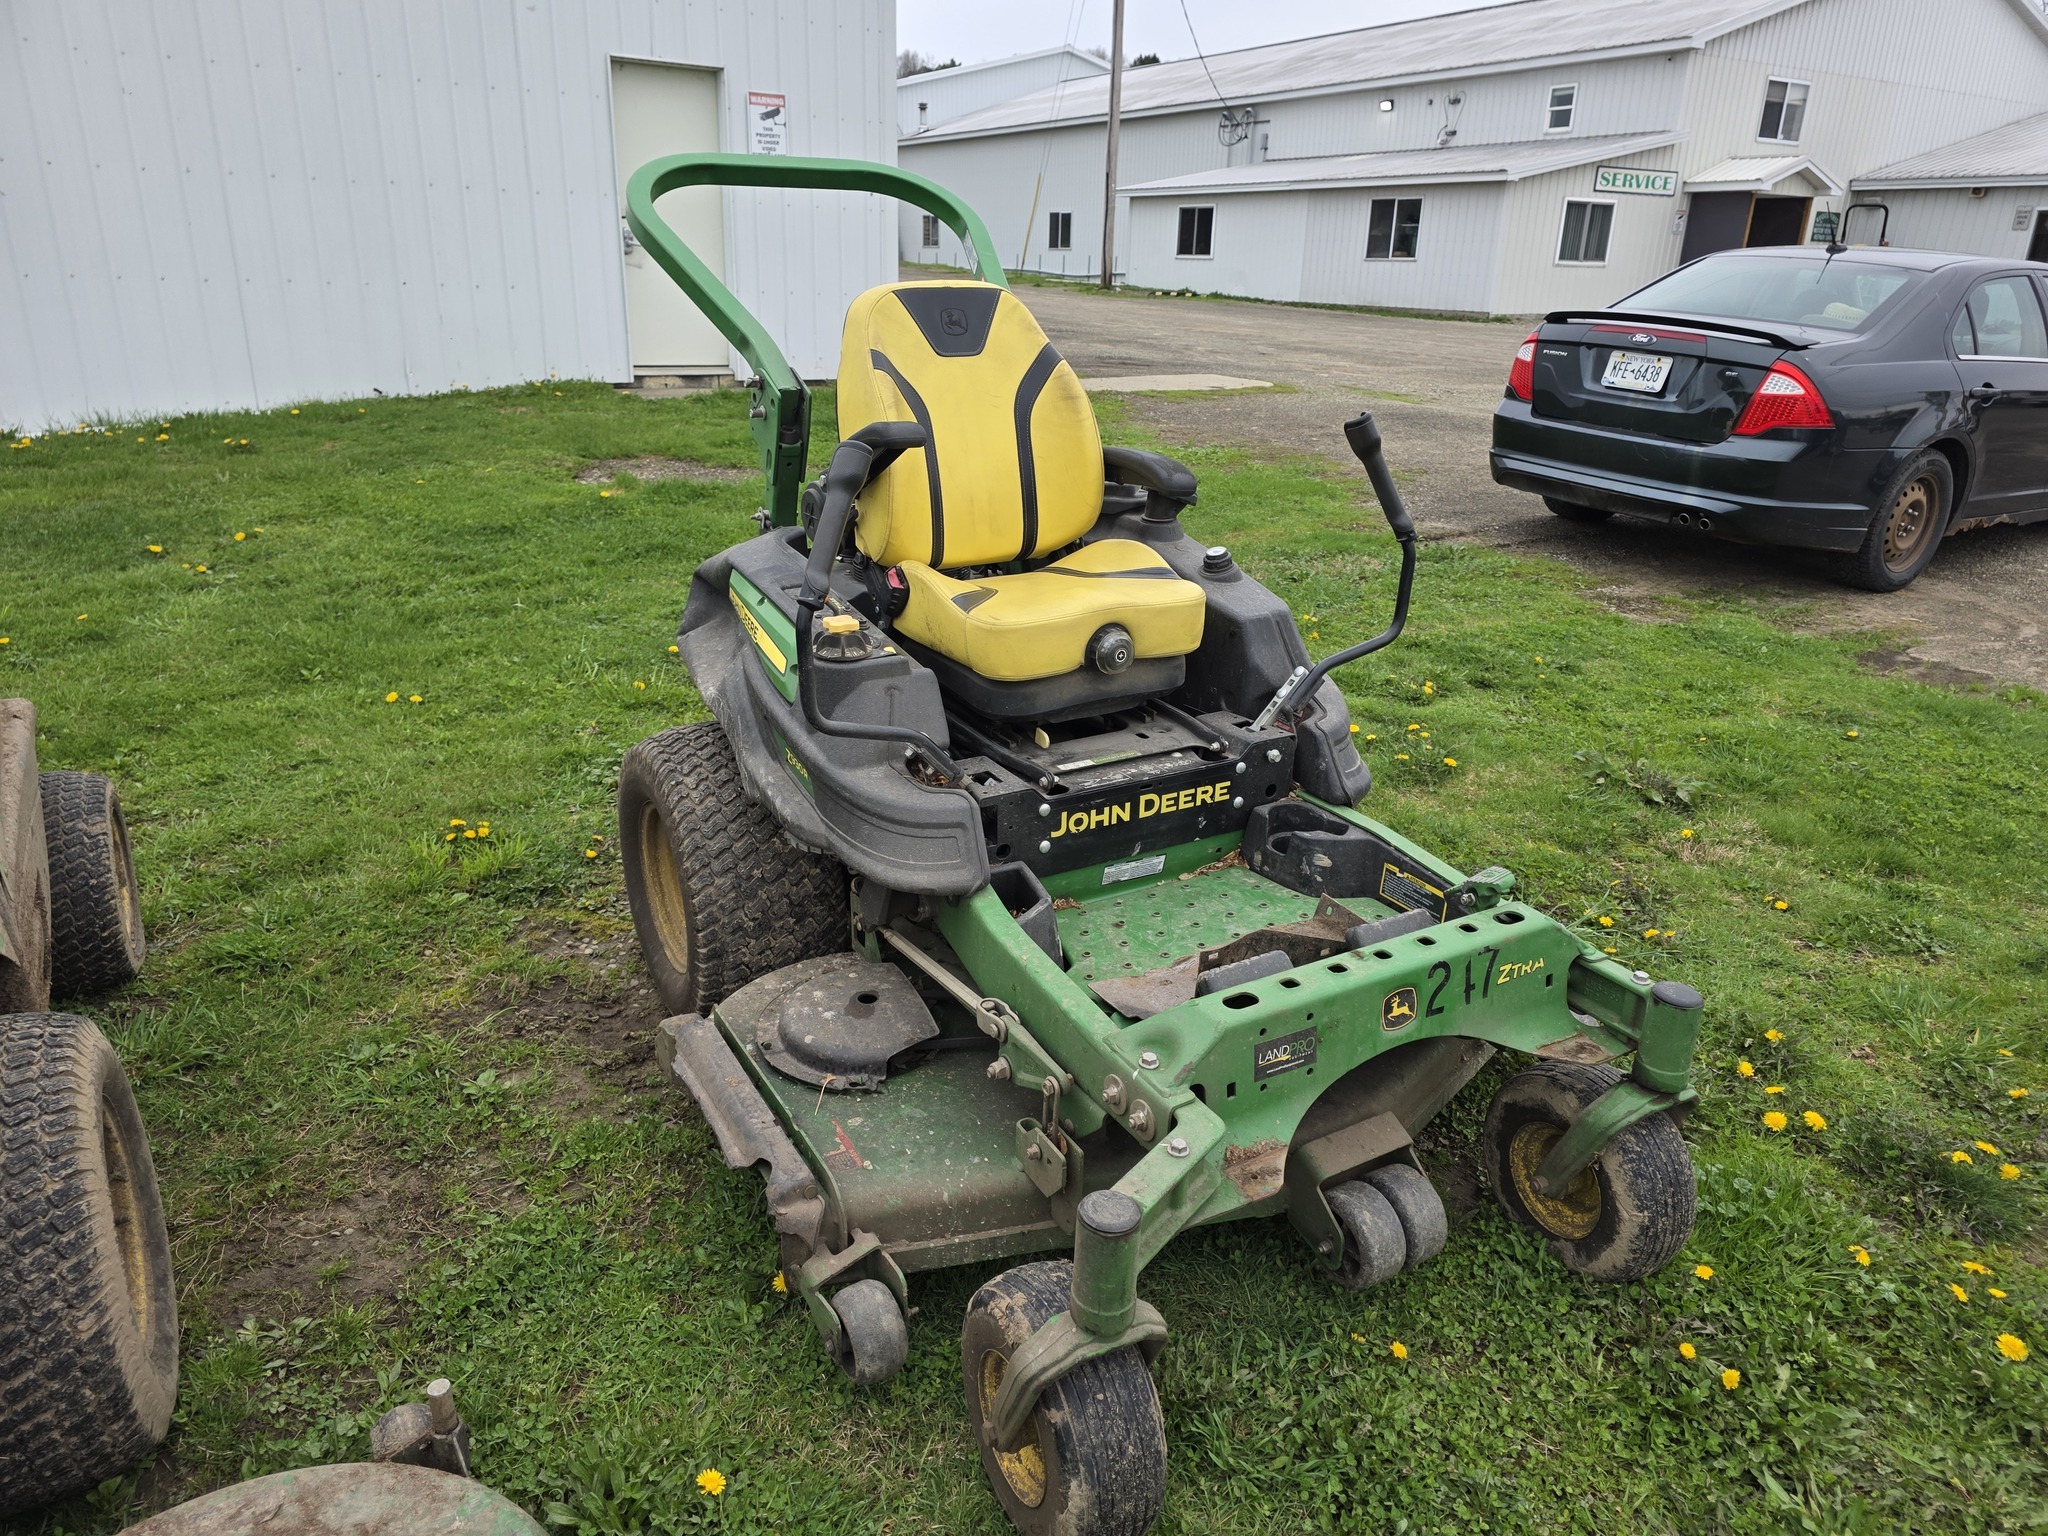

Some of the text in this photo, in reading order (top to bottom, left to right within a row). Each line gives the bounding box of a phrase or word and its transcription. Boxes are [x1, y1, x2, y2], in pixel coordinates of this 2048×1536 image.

[1600, 171, 1672, 191] SERVICE
[1050, 781, 1231, 838] JOHN DEERE
